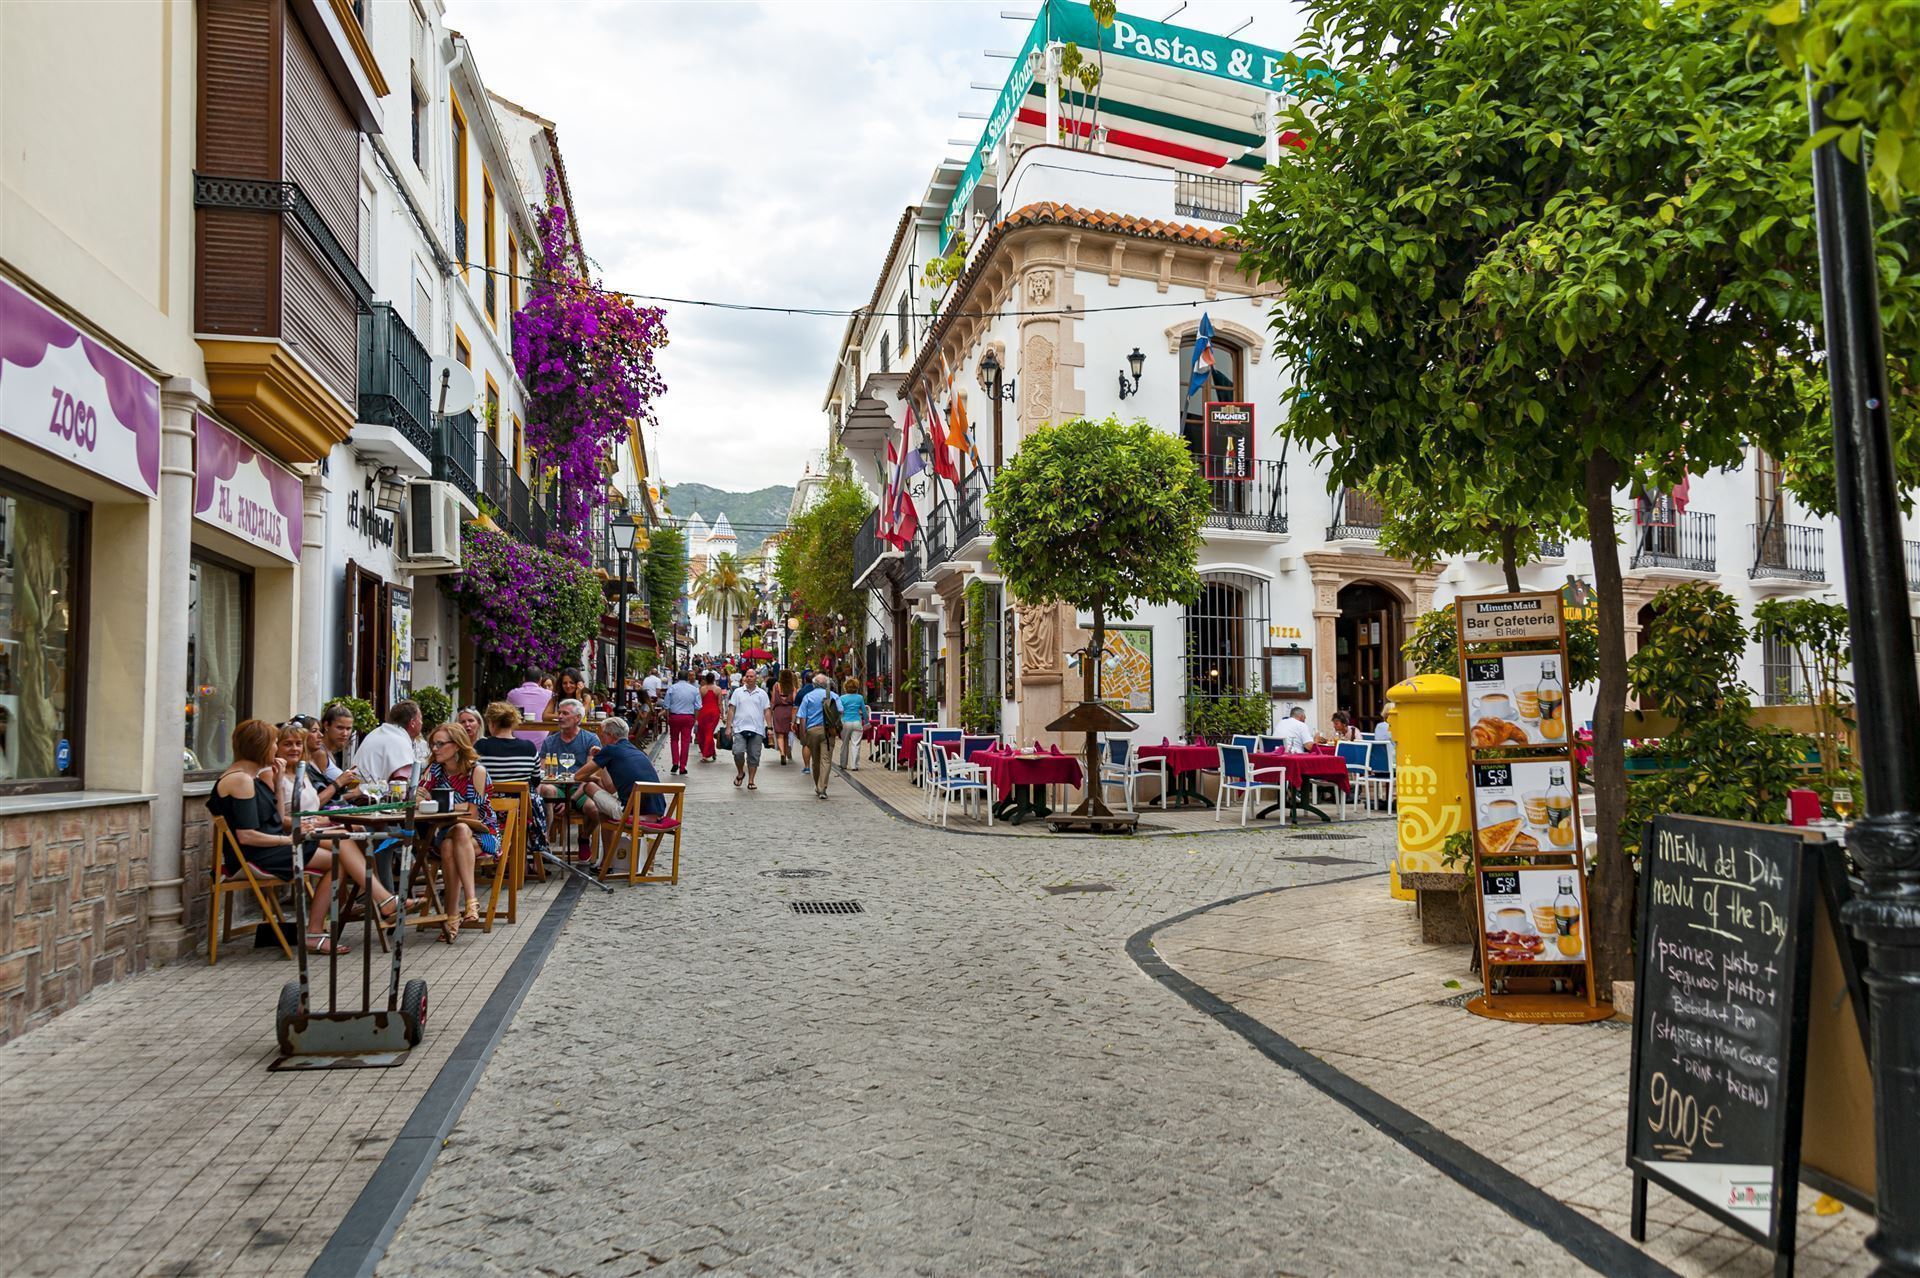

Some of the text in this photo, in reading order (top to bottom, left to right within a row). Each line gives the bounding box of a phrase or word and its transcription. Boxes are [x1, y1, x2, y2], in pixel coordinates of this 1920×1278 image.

[1113, 20, 1218, 72] Pastas
[1227, 48, 1253, 80] &
[988, 92, 1011, 148] Steak
[49, 385, 97, 453] ZOCO
[1214, 413, 1247, 421] MAGNERS
[1238, 437, 1246, 477] ORIGINAL
[218, 485, 281, 547] AL ANDALUS
[1467, 618, 1490, 629] Bar
[1480, 601, 1537, 613] Minute Maid
[1270, 625, 1302, 639] PIZZA
[1496, 627, 1526, 637] El Reloj
[1714, 843, 1737, 880] del
[1703, 884, 1720, 929] of
[1726, 890, 1756, 929] the
[1728, 1186, 1745, 1206] San
